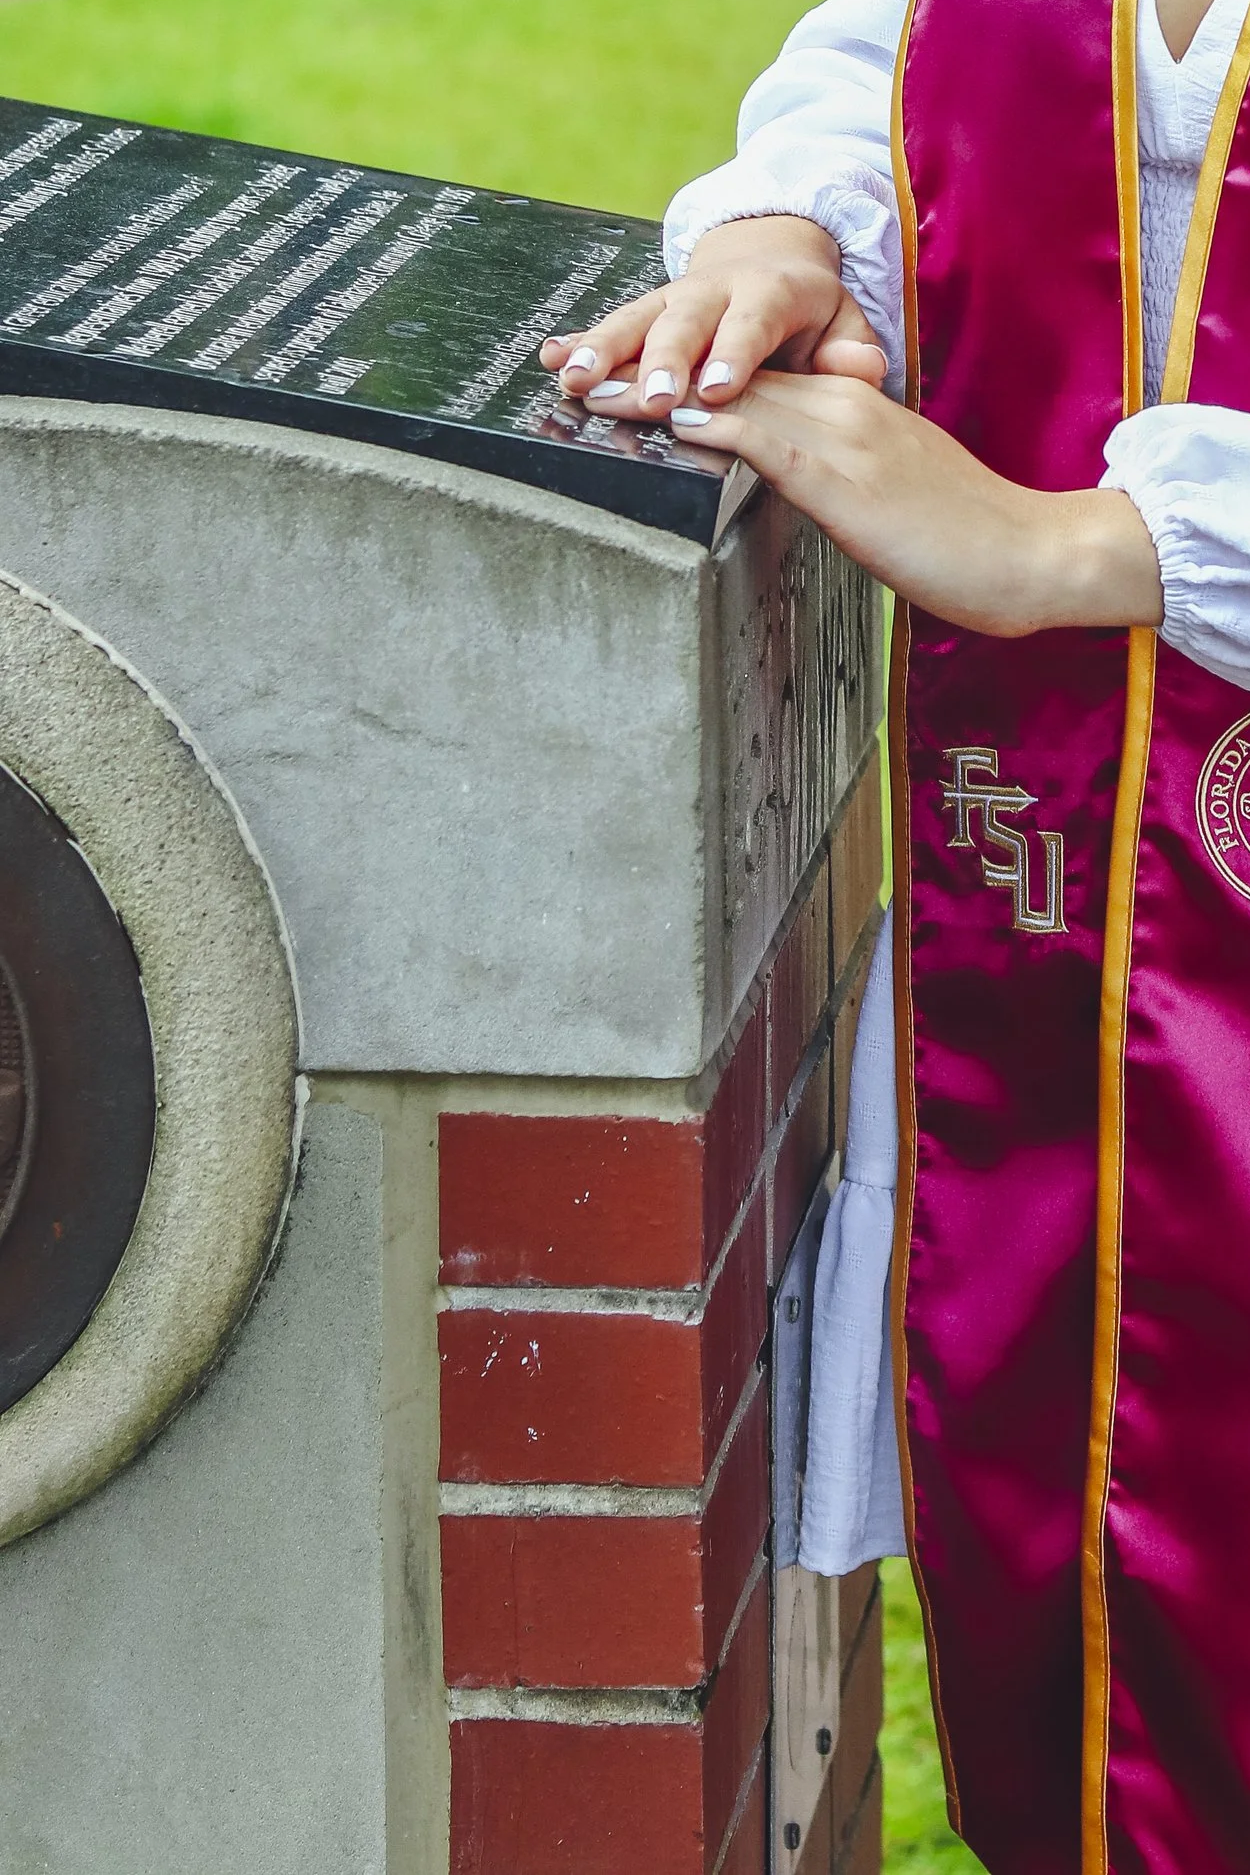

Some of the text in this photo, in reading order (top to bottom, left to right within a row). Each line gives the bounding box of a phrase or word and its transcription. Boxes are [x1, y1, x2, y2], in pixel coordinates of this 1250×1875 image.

[224, 193, 265, 214] years
[367, 189, 408, 202] He
[126, 202, 183, 225] Florida
[205, 209, 246, 224] two
[274, 197, 330, 224] degrees
[105, 232, 145, 243] in
[114, 222, 159, 236] the
[167, 221, 240, 252] including
[253, 220, 303, 249] master's
[328, 214, 380, 238] Florida
[87, 236, 135, 263] served
[237, 242, 274, 261] and
[308, 235, 359, 253] from
[63, 260, 108, 277] who
[189, 257, 260, 292] bachelor's
[266, 250, 340, 297] administration
[567, 271, 597, 283] on
[25, 274, 88, 306] educator
[111, 276, 165, 295] from
[176, 289, 223, 303] his
[529, 280, 597, 313] University
[161, 296, 212, 325] earned
[228, 294, 292, 329] education
[252, 353, 300, 382] served
[286, 315, 342, 352] president
[317, 274, 387, 311] Tallahassee
[357, 238, 431, 276] Community
[394, 216, 452, 241] College
[2, 302, 51, 327] career
[47, 290, 144, 346] Representatives
[515, 311, 562, 331] State
[111, 320, 182, 357] Wetherell
[214, 326, 256, 338] in
[493, 329, 549, 355] Florida
[176, 334, 247, 370] doctorate
[474, 349, 526, 385] attended
[315, 371, 356, 394] until
[435, 380, 498, 419] Wetherell
[939, 747, 1069, 933] FSU
